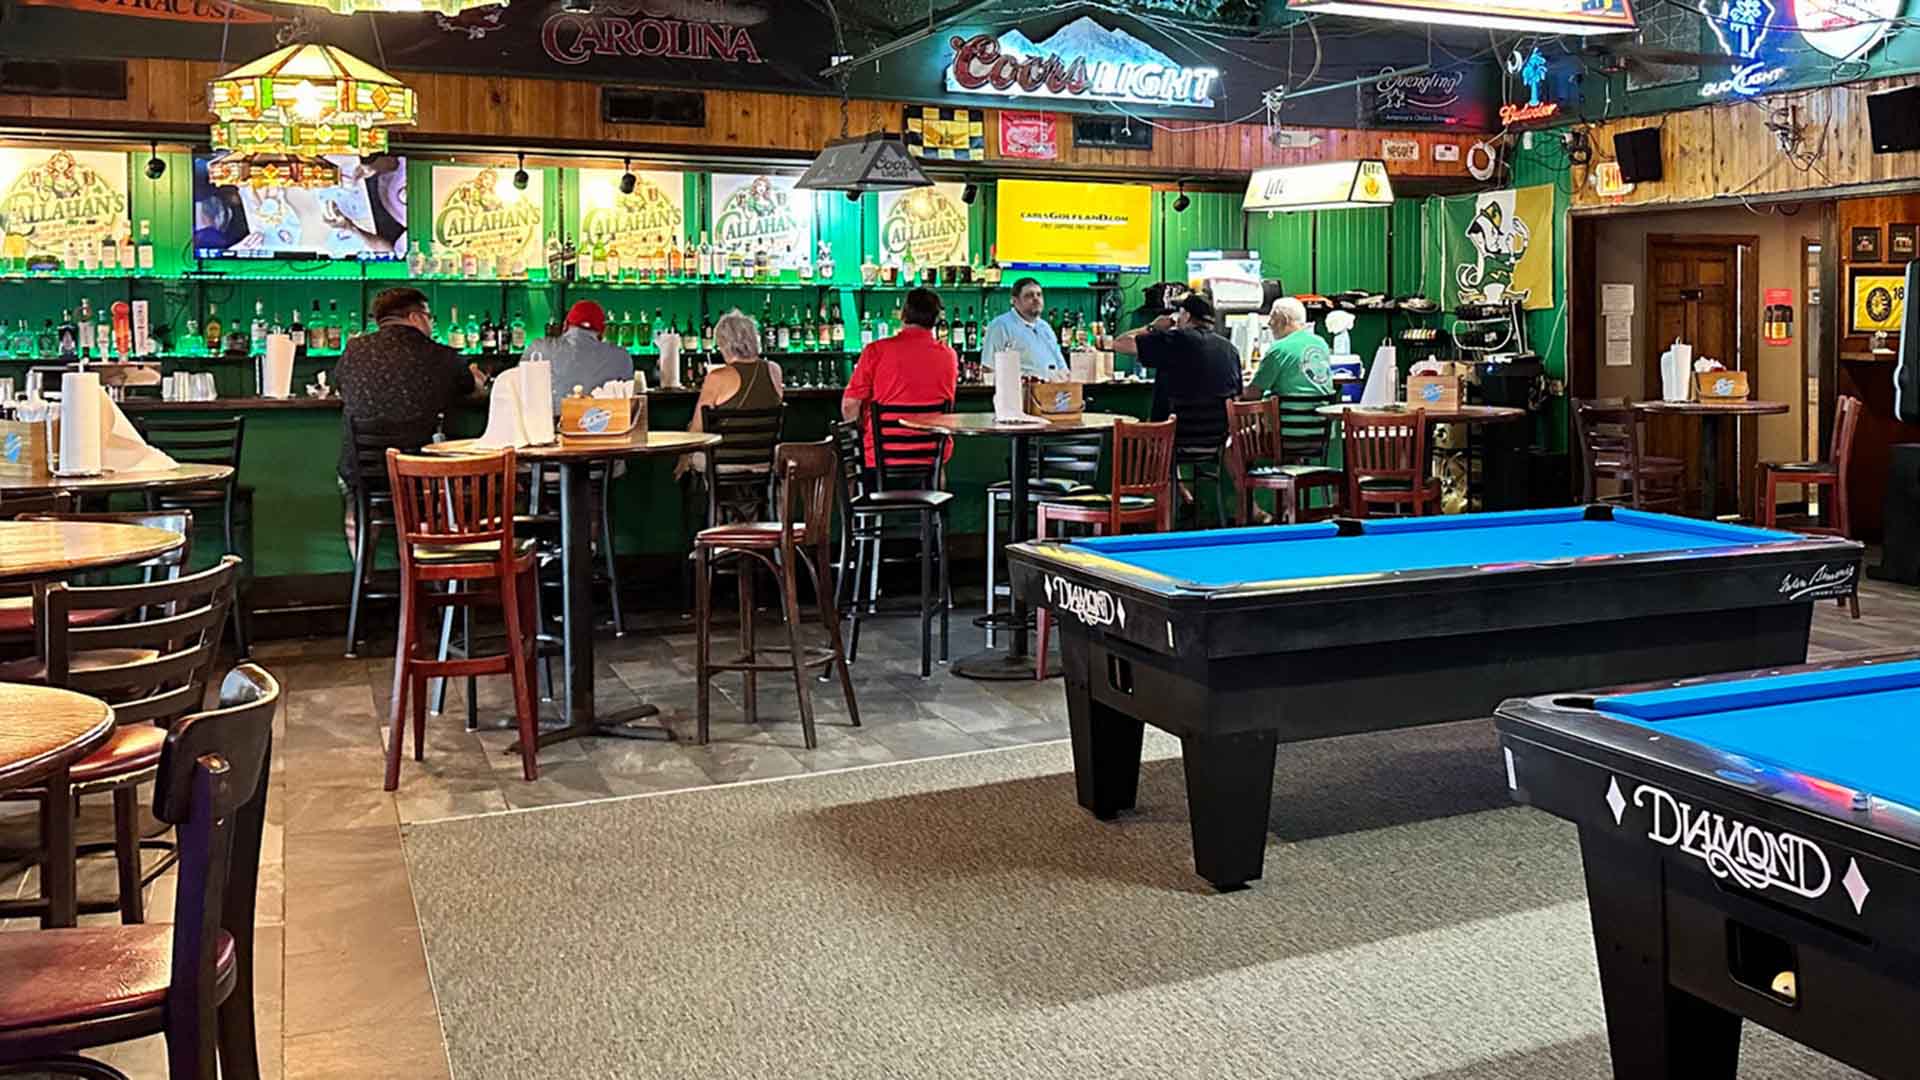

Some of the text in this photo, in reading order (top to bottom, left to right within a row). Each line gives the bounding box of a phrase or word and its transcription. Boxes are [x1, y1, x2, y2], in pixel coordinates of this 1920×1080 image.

[542, 12, 762, 64] CAROLINA
[949, 34, 1219, 101] Coors LIGHT
[1376, 66, 1463, 94] Yuengling
[874, 155, 914, 172] Coors
[436, 206, 540, 248] CALLAHAN'S
[882, 215, 966, 253] CALLAHAN'S
[1052, 576, 1115, 626] DIAMOND
[1634, 785, 1832, 898] DIAMOND
